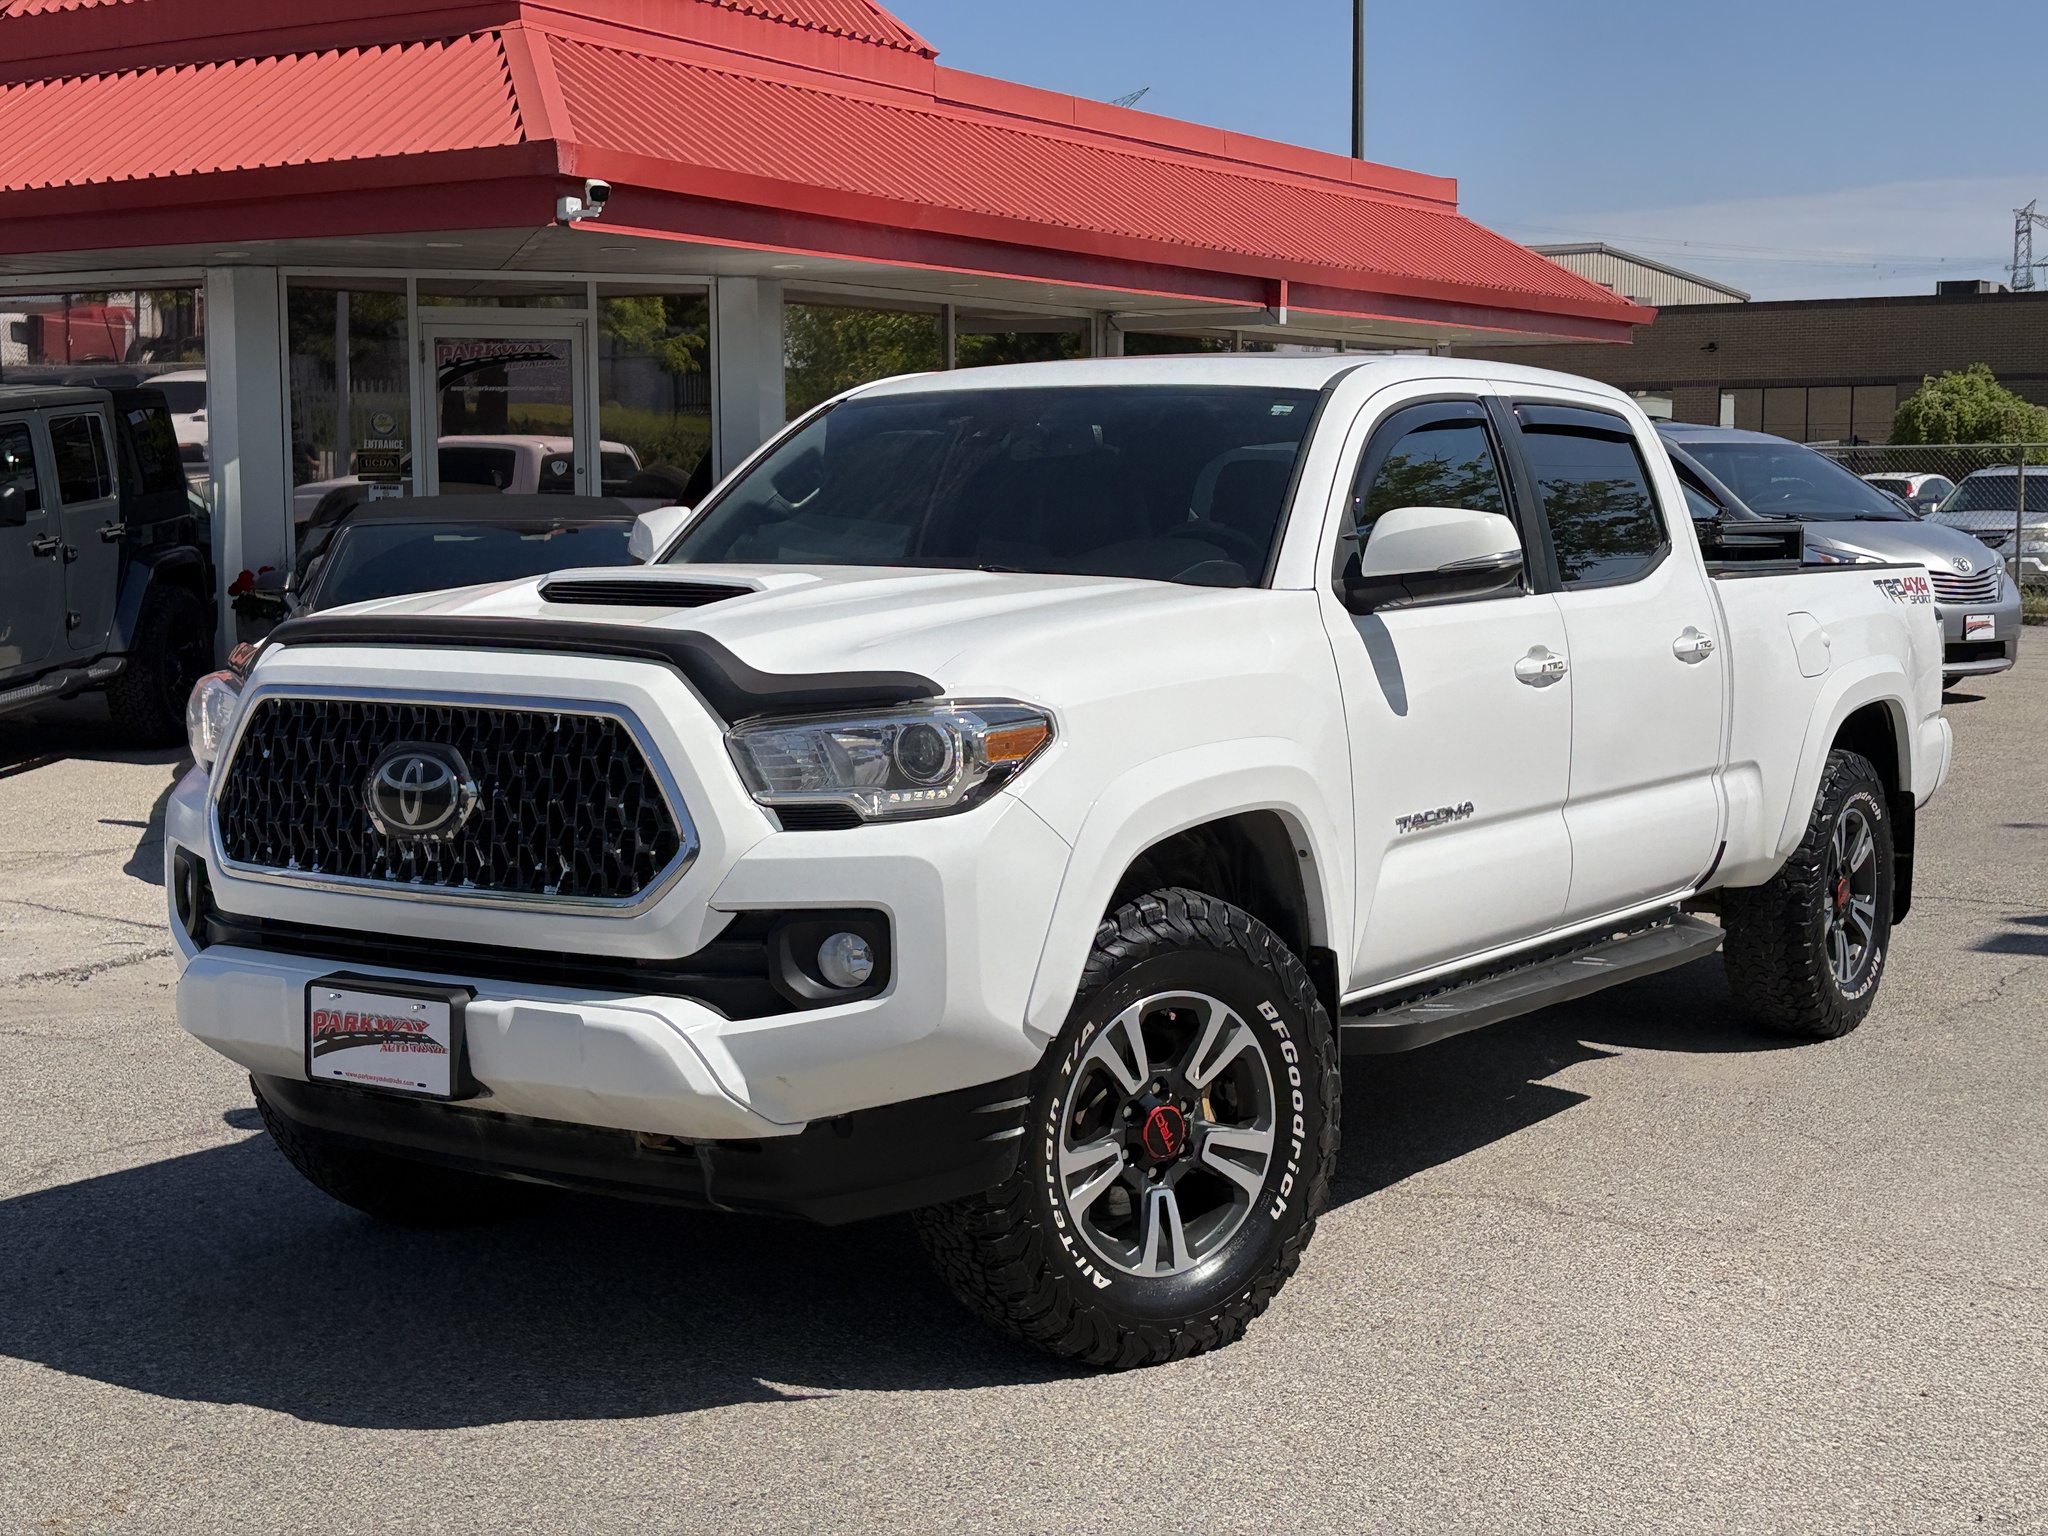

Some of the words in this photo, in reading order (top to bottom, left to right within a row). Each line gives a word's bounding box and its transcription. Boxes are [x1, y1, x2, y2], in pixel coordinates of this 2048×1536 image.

[437, 341, 552, 367] PARKWAY
[363, 439, 404, 449] ENTRANCE
[364, 458, 395, 467] UCDA
[1909, 594, 1931, 605] SPORT
[1394, 800, 1475, 834] TACOMA
[313, 1008, 431, 1037] PARKWAY
[1060, 1020, 1096, 1077] T/A
[1256, 999, 1306, 1221] BFGoodrich
[1155, 1112, 1175, 1153] TRD
[1045, 1097, 1113, 1290] All-Terrain
